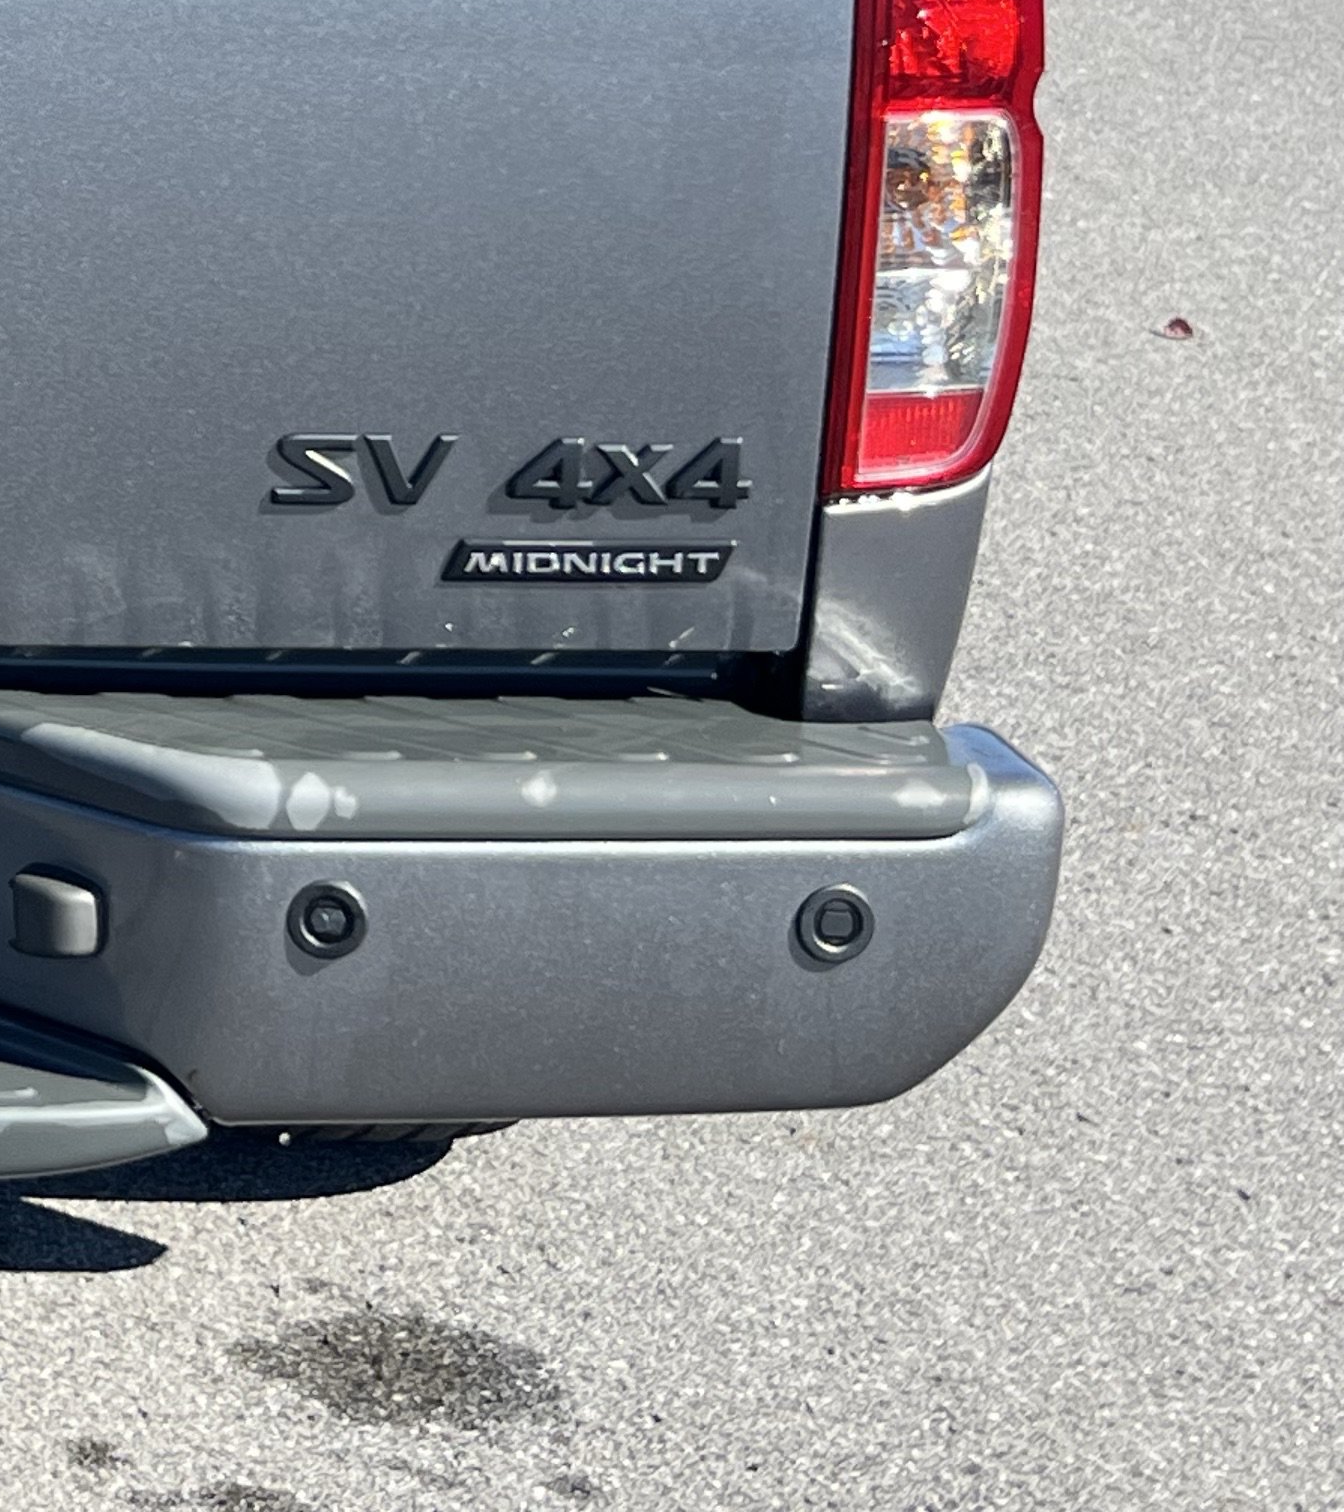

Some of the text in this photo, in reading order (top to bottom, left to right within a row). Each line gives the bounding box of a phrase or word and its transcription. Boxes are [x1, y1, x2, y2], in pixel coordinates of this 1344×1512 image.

[269, 432, 753, 509] SV 4X4
[463, 551, 721, 575] MIDNIGHT
